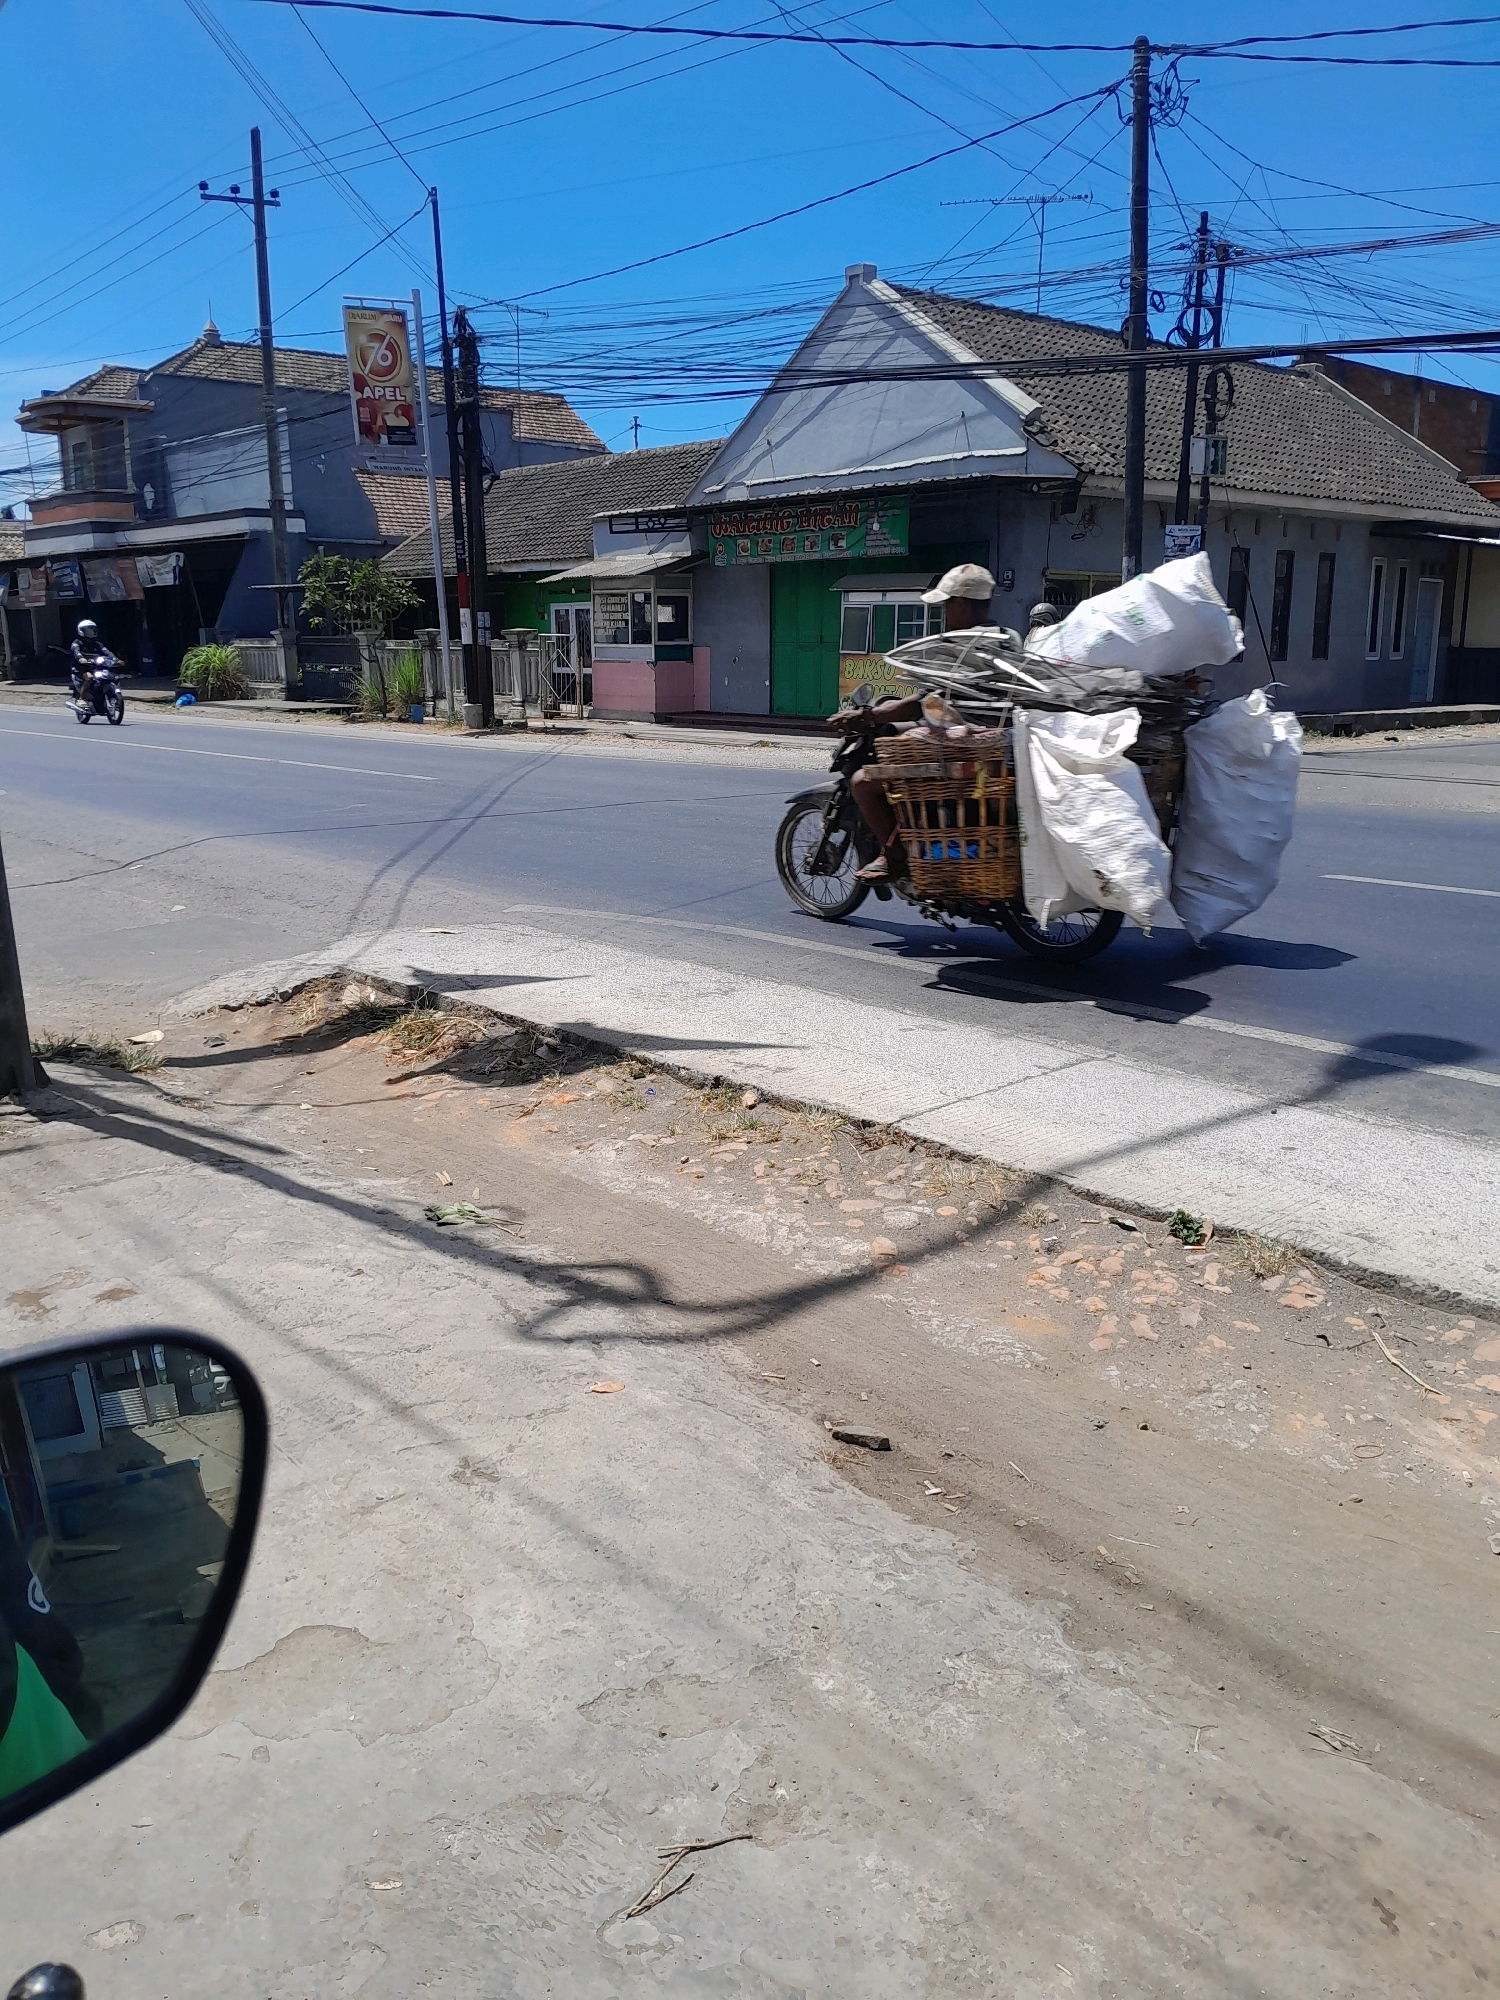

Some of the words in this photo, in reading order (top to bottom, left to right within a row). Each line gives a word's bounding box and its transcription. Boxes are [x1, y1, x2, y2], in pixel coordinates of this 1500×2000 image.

[348, 312, 377, 320] DJARUM
[359, 334, 393, 375] 76
[362, 385, 406, 401] APEL
[844, 658, 896, 681] BAKSO
